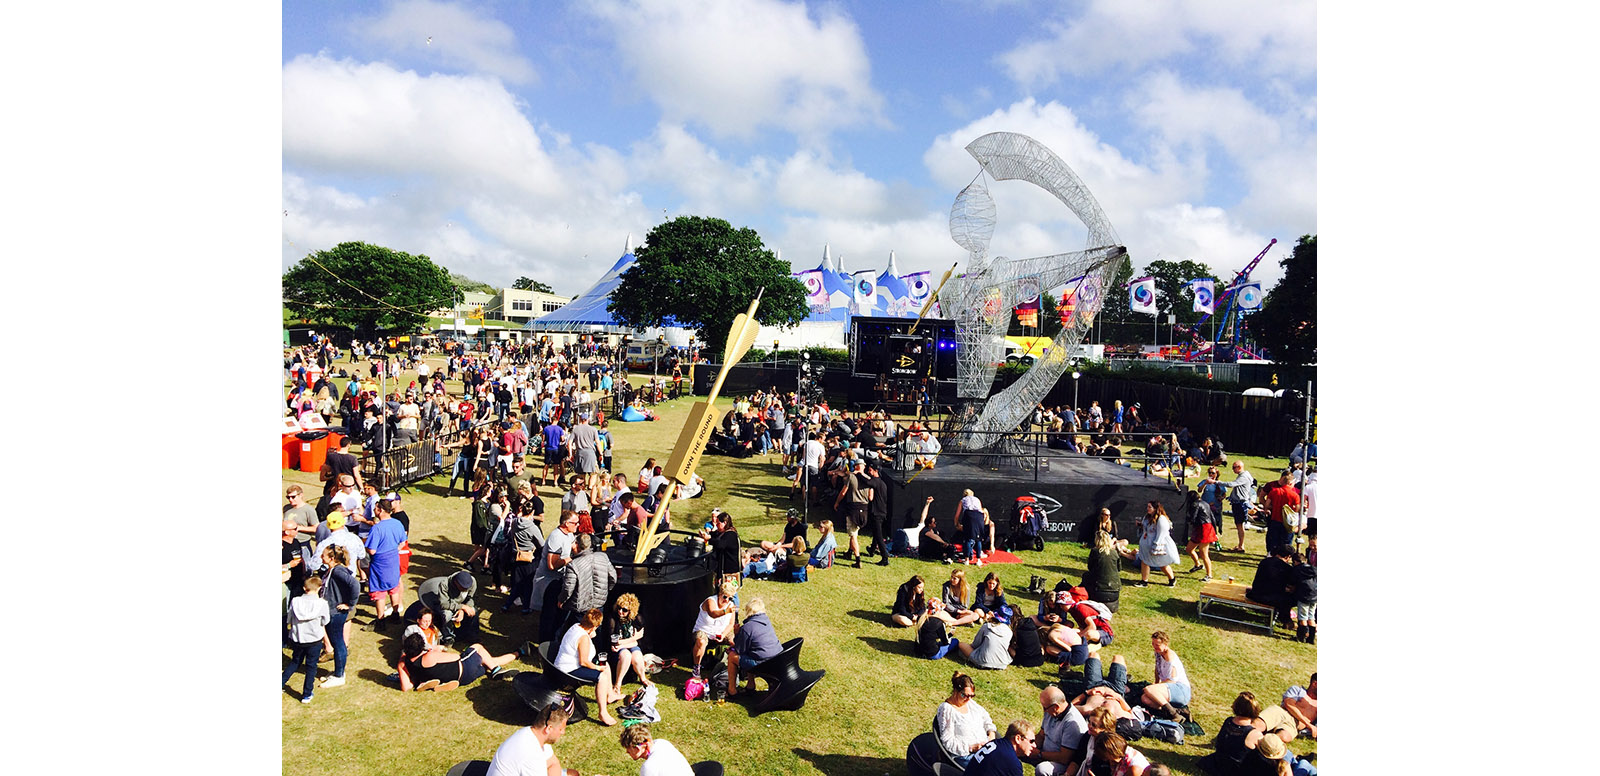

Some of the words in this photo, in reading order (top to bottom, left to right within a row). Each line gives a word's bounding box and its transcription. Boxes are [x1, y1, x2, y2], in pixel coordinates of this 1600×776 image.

[683, 456, 695, 476] OWN
[692, 440, 702, 455] THE
[699, 413, 713, 440] ROUND
[974, 741, 997, 764] 2
